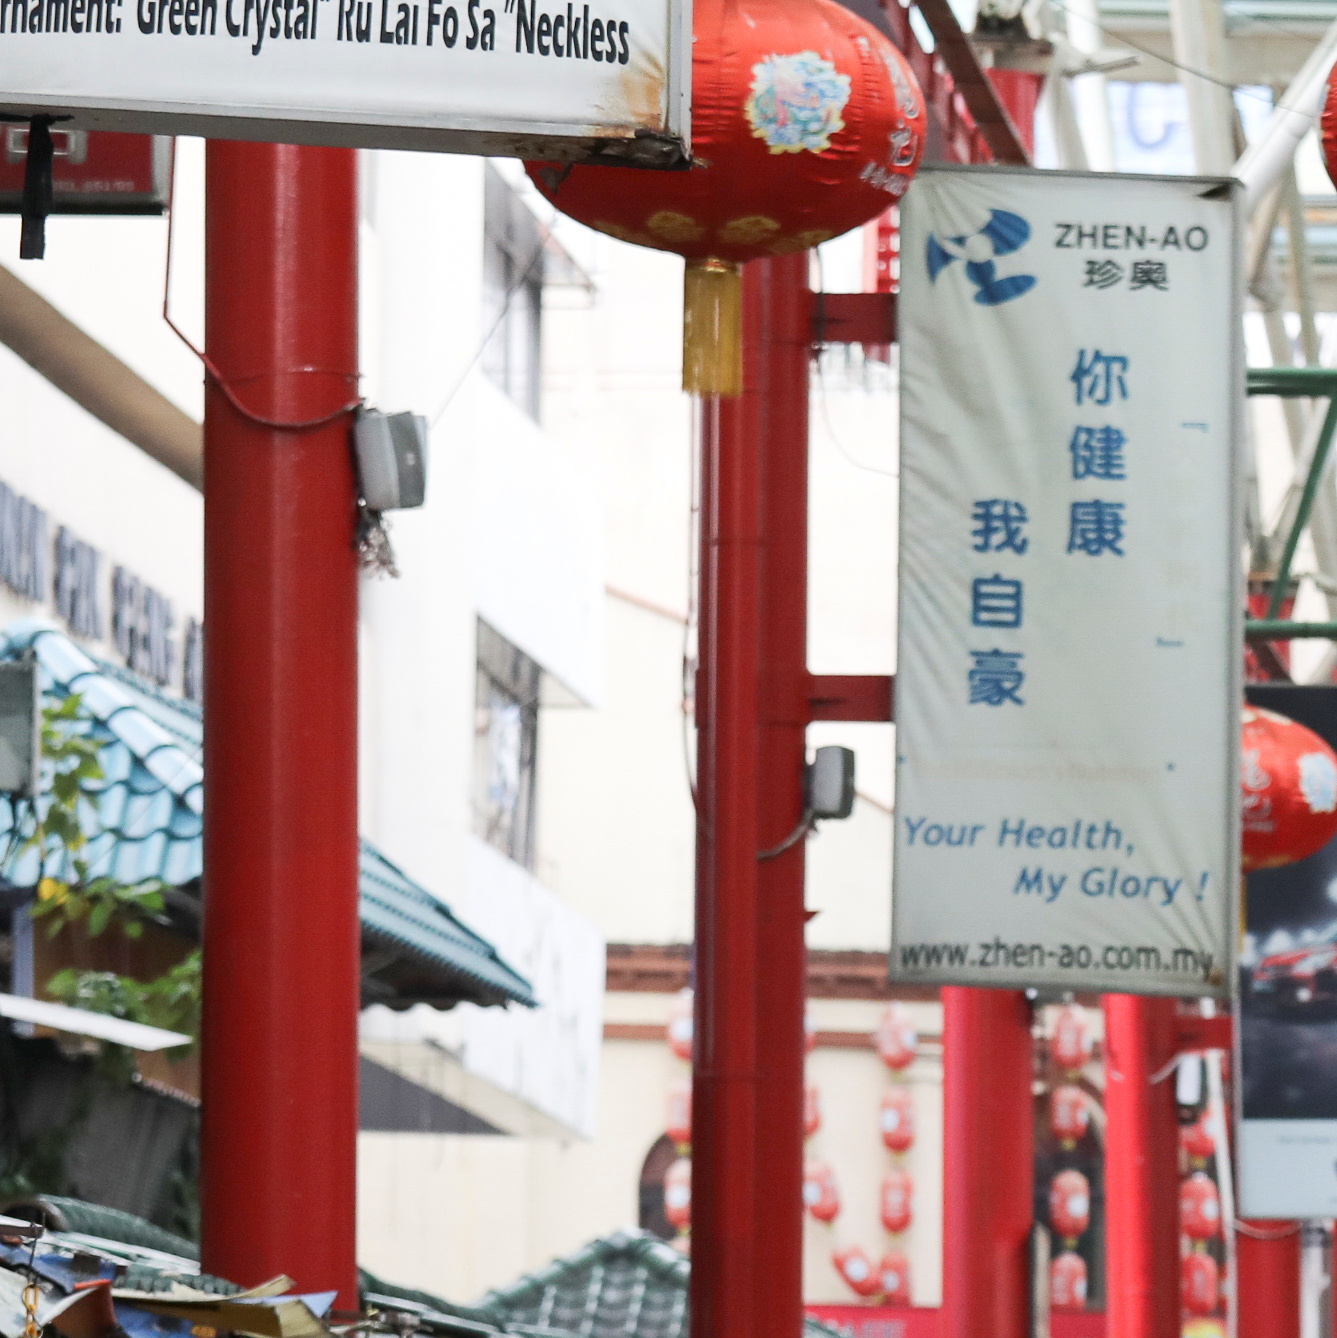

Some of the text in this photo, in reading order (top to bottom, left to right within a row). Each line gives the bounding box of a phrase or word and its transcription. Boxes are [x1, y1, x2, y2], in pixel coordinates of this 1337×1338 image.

[0, 0, 123, 33] rnament:
[226, 0, 321, 56] Crystal
[337, 0, 372, 43] Ru
[380, 0, 419, 46] Lai
[426, 0, 459, 49] Fo
[466, 0, 496, 51] Sa
[1054, 222, 1210, 251] ZHEN-AO
[1067, 349, 1130, 557] 你健康
[968, 499, 1029, 707] 我自豪
[904, 816, 1135, 857] Your Health,
[1013, 864, 1209, 905] My Glory !
[899, 936, 1214, 982] www.zhen-ao.com.my
